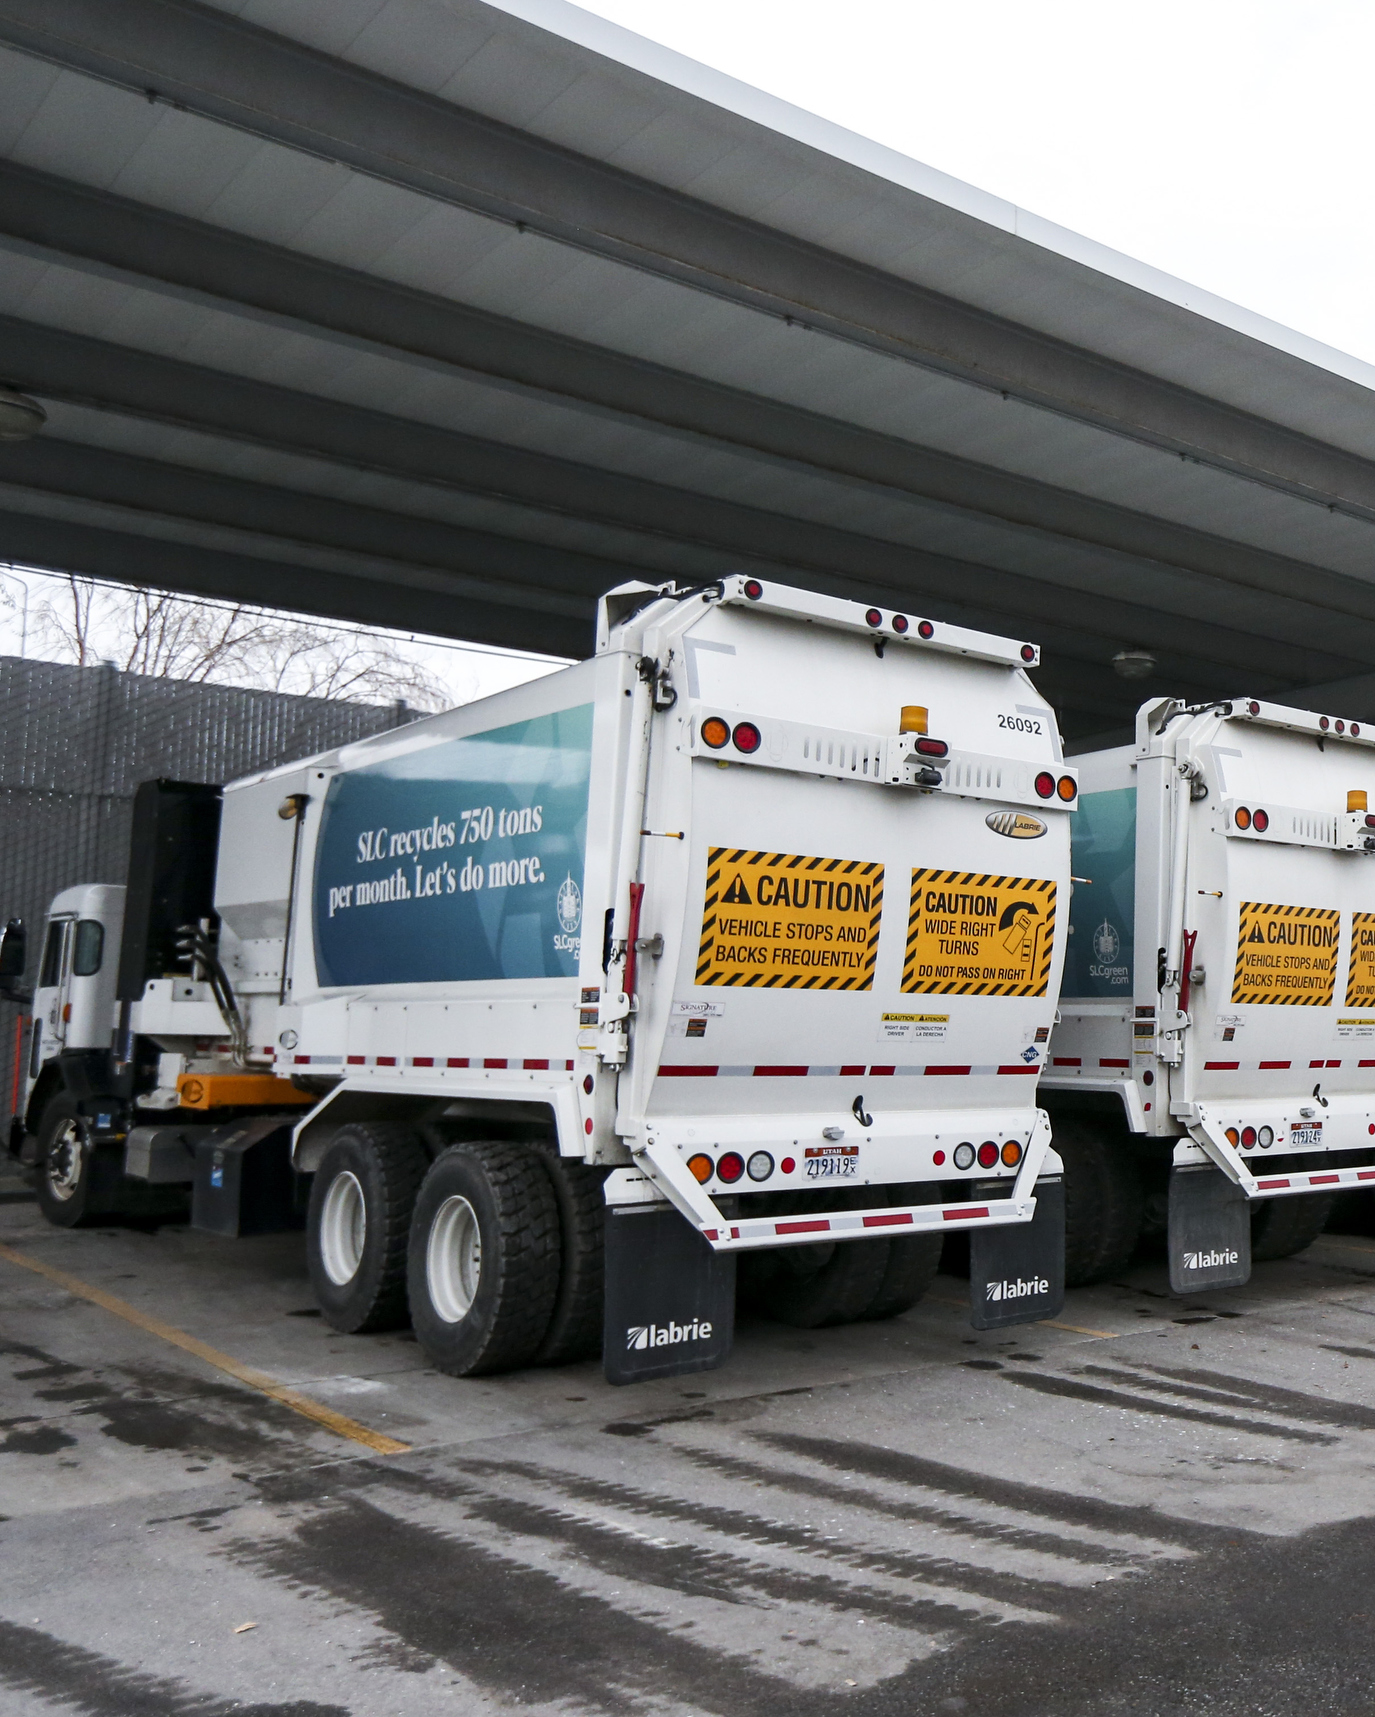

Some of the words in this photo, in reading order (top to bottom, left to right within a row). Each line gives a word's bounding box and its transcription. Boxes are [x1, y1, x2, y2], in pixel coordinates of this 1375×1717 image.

[998, 714, 1043, 736] 26092
[356, 827, 388, 863] SLC
[389, 816, 456, 862] recycles
[460, 806, 494, 845] 750
[498, 805, 543, 839] tons
[1014, 822, 1042, 832] LABRIE
[328, 885, 354, 918] per
[356, 867, 412, 906] month.
[414, 861, 456, 898] Let's
[460, 856, 484, 892] do
[488, 856, 546, 889] more.
[756, 874, 872, 913] CAUTION
[925, 890, 998, 917] CAUTION
[718, 918, 782, 938] VEHICLE
[786, 922, 833, 942] STOPS
[836, 926, 867, 943] AND
[925, 919, 956, 936] WIDE
[960, 921, 996, 937] RIGHT
[1267, 920, 1332, 948] CAUTION
[716, 946, 768, 964] BACKS
[772, 948, 865, 968] FREQUENTLY
[938, 940, 980, 956] TURNS
[1090, 965, 1128, 978] SLCgreen
[1246, 954, 1282, 968] VEHICLE
[1284, 956, 1311, 970] STOPS
[1312, 958, 1330, 970] AND
[918, 964, 933, 977] DO
[935, 966, 956, 978] NOT
[956, 966, 980, 978] PASS
[982, 968, 996, 980] ON
[998, 968, 1026, 980] RIGHT
[1110, 976, 1129, 984] .com
[1242, 974, 1272, 987] BACKS
[1274, 974, 1328, 990] FREQUENTLY
[1356, 985, 1366, 994] DO
[890, 1014, 915, 1022] CAUTION
[807, 1158, 850, 1176] 219119
[1198, 1248, 1238, 1268] labrie
[1002, 1275, 1050, 1300] labrie
[649, 1318, 713, 1348] labrie
